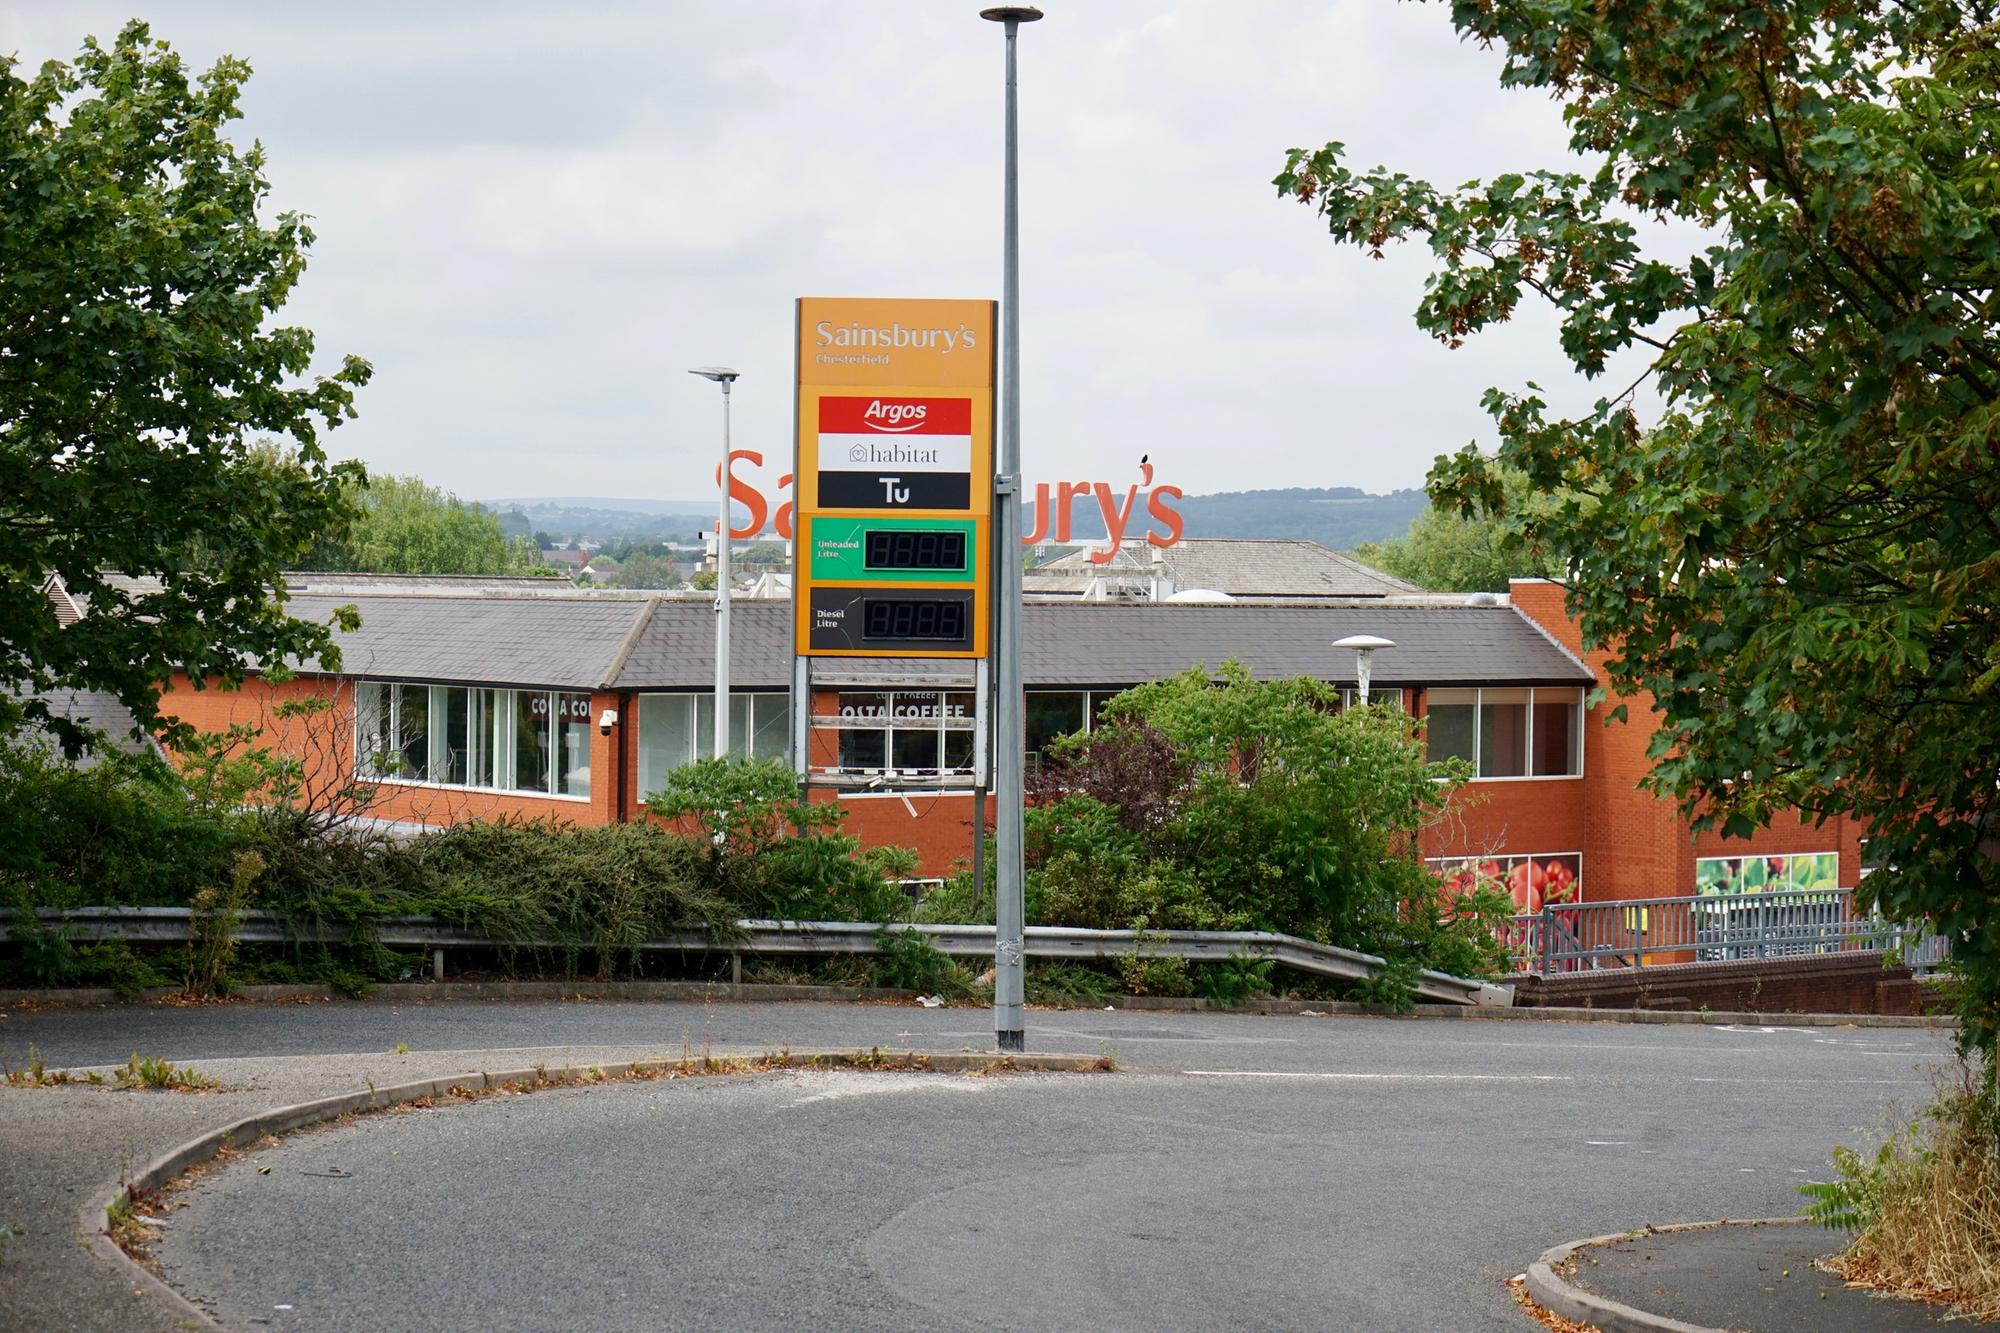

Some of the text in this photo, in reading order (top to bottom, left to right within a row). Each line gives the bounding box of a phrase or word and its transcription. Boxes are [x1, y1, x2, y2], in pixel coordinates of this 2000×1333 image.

[815, 320, 977, 354] Sainsbury's
[815, 353, 890, 366] Chesterfield
[863, 399, 927, 424] Argos
[870, 444, 939, 464] habitat
[878, 477, 910, 504] Tu
[817, 540, 860, 549] Unleaded
[817, 550, 840, 558] Litre
[816, 610, 845, 619] Diesel
[816, 620, 838, 629] Litre
